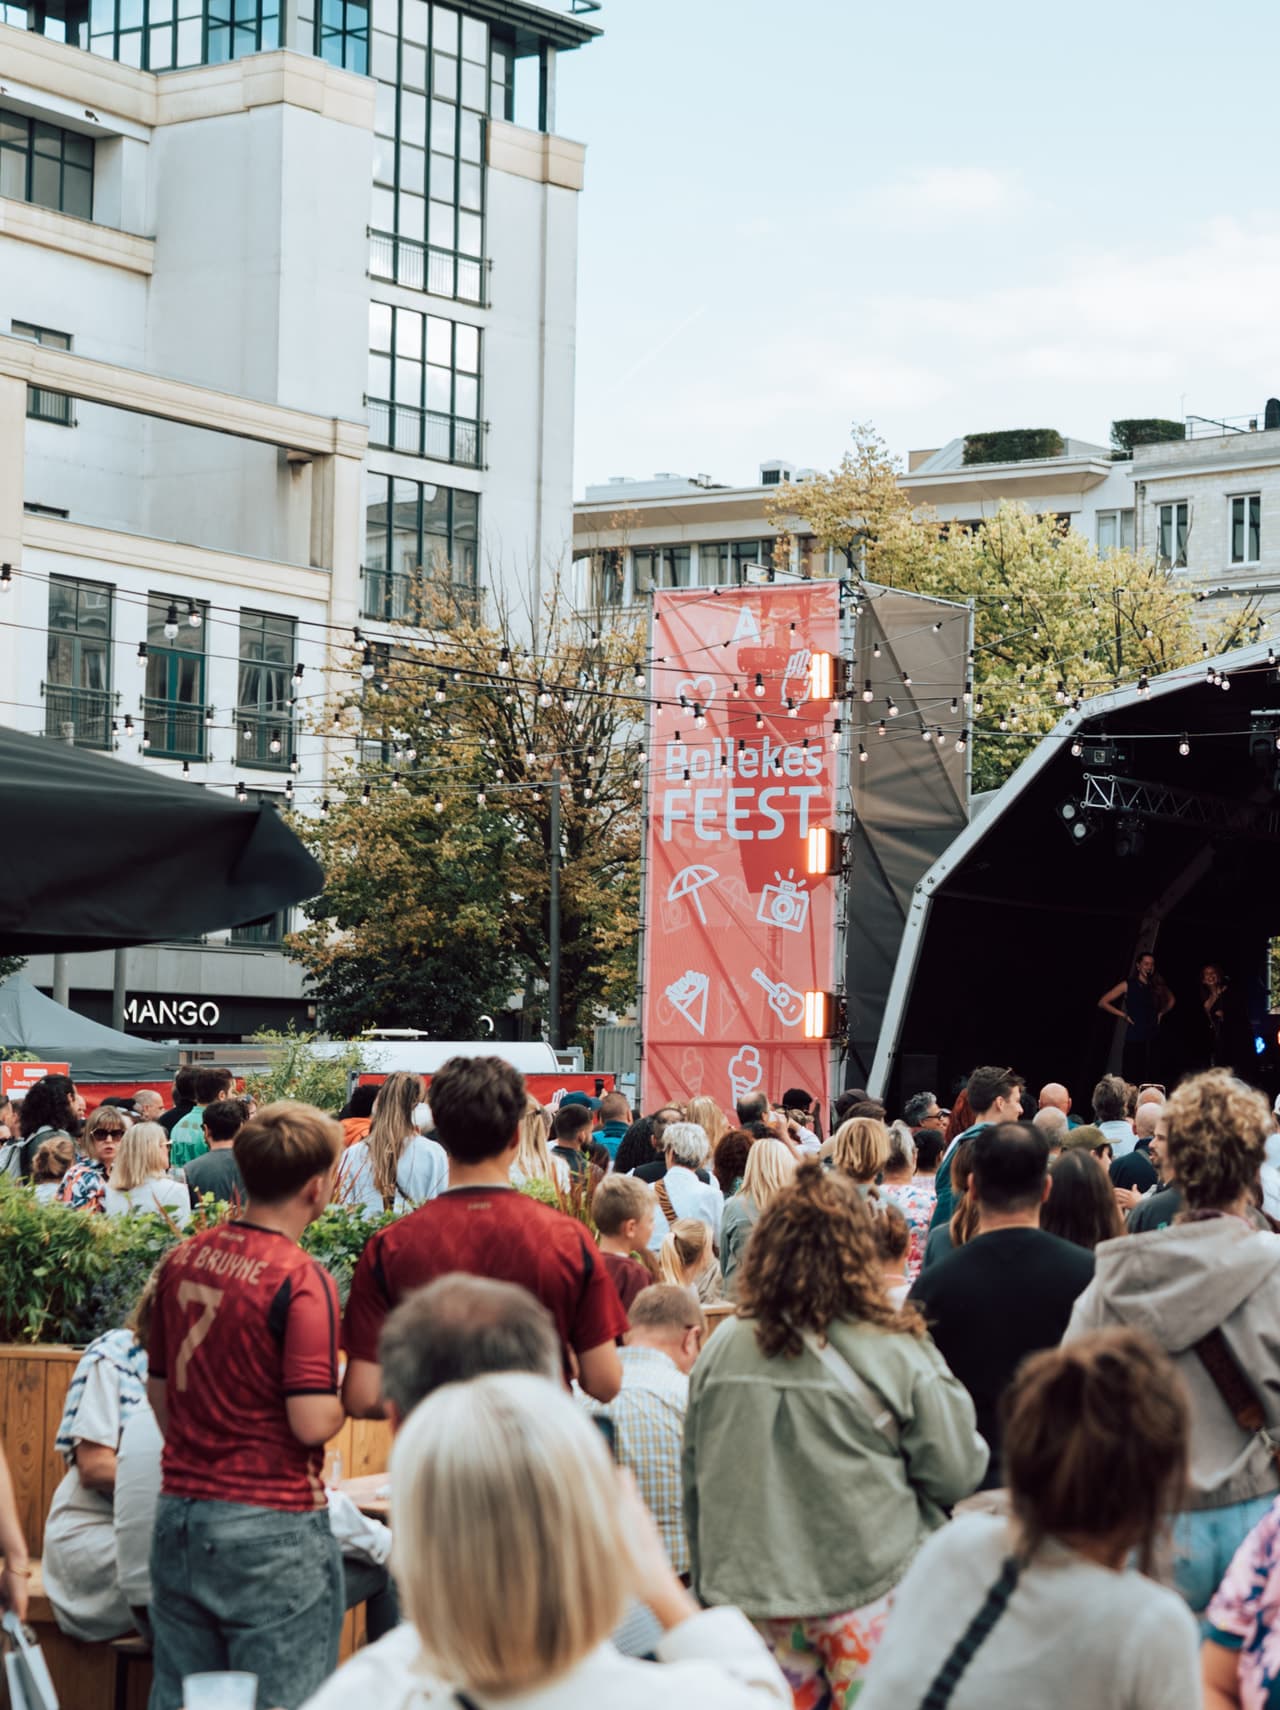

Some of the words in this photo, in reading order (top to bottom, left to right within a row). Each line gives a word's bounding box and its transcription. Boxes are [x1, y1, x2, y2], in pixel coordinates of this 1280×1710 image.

[732, 605, 761, 644] A
[665, 736, 823, 781] Bollekes
[663, 786, 823, 842] FEEST
[123, 998, 220, 1027] MANGO
[193, 1245, 270, 1286] BRUYNE
[176, 1279, 224, 1393] 7
